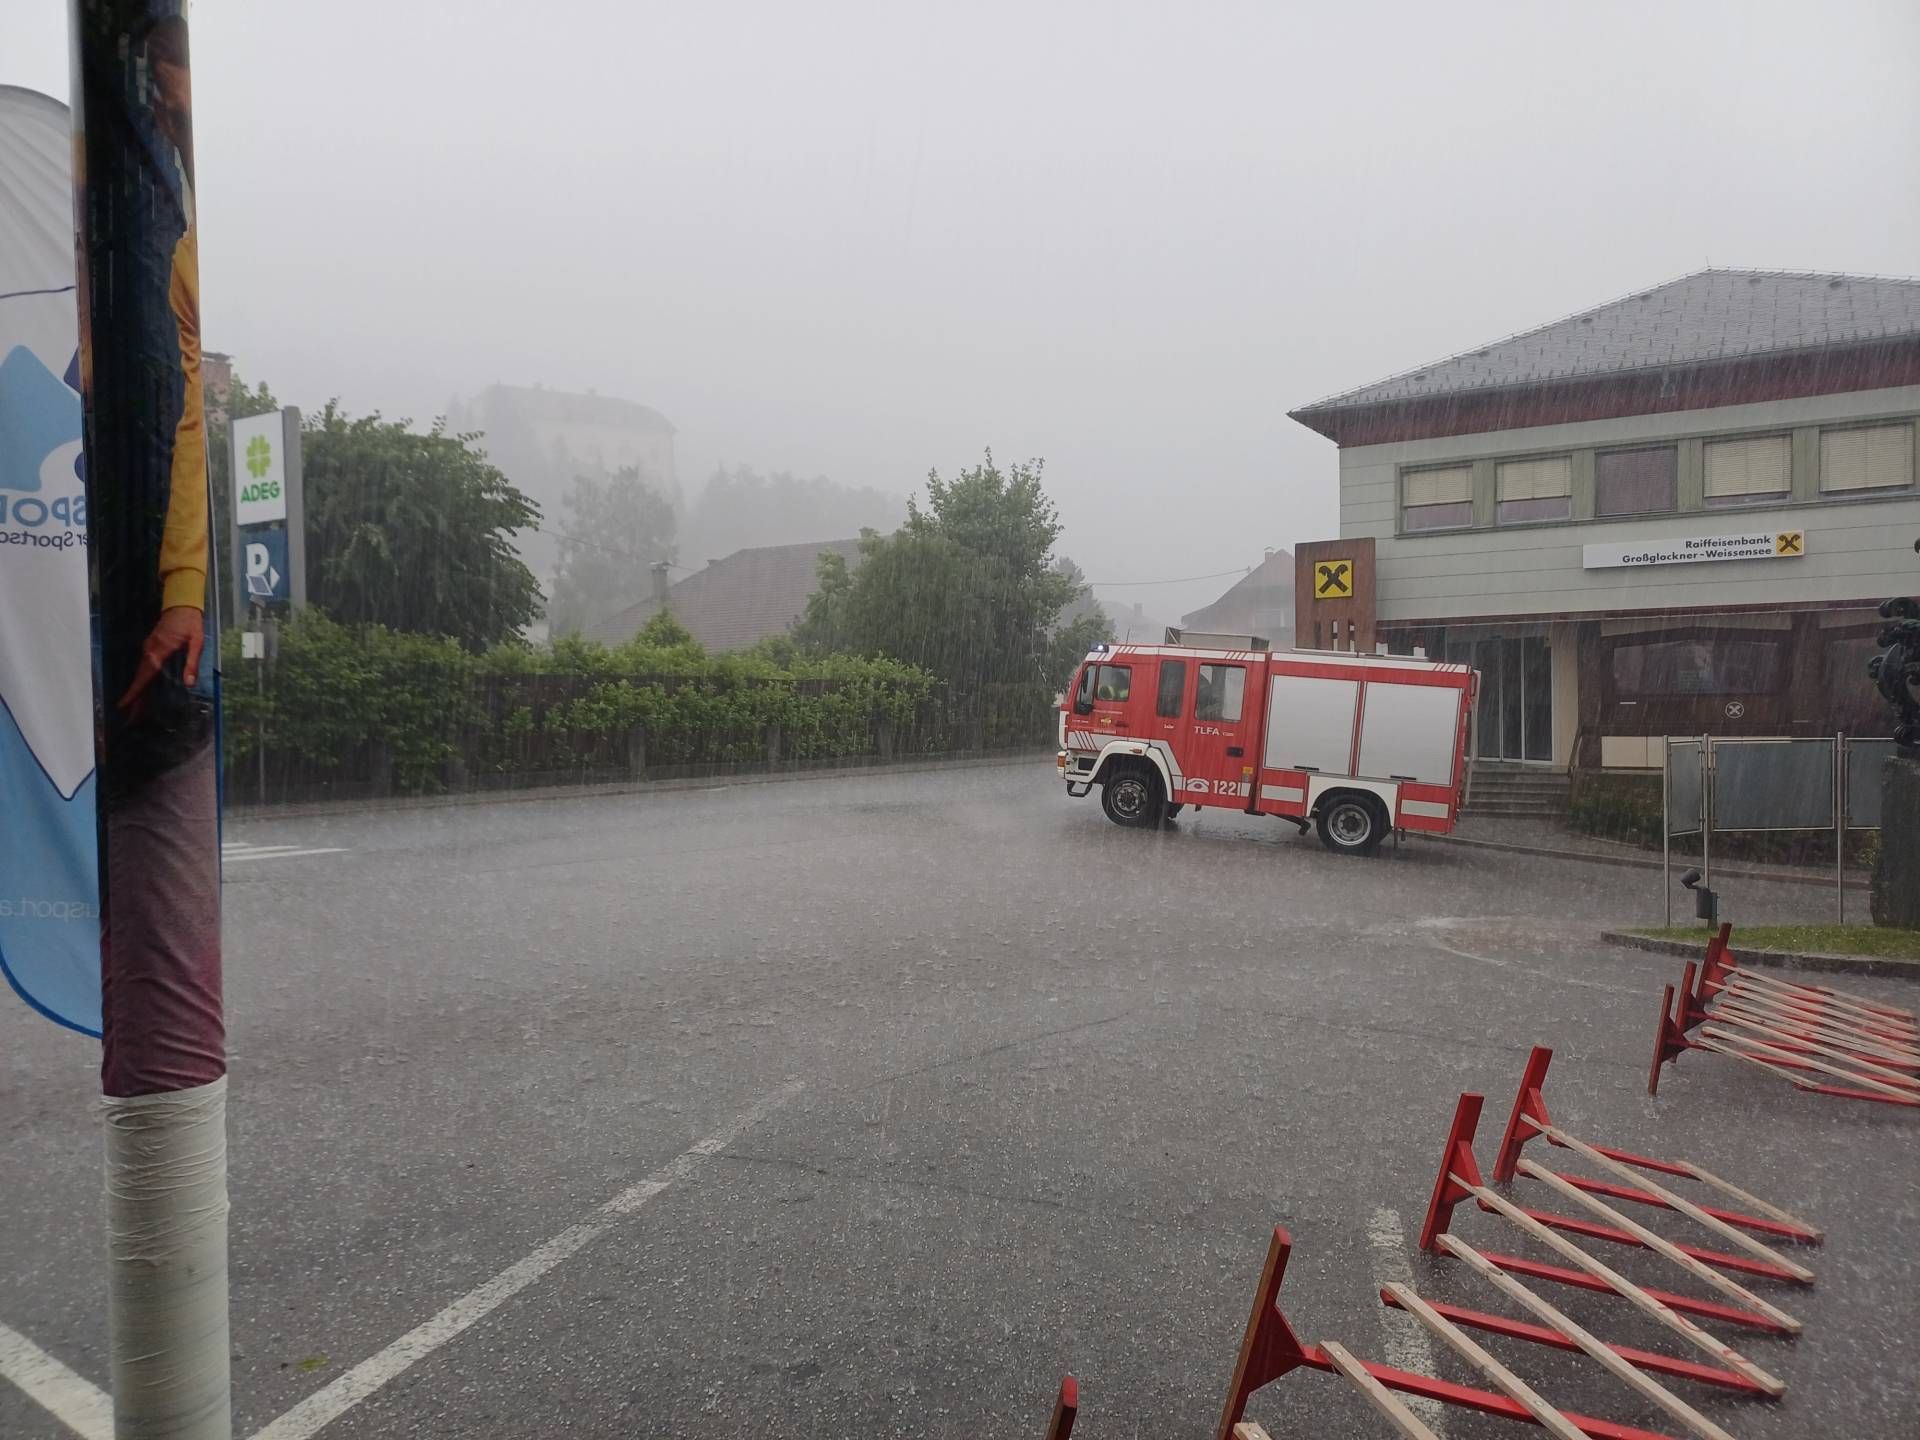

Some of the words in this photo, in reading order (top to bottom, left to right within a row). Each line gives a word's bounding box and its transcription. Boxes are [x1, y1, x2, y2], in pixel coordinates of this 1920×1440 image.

[241, 481, 281, 503] ADEG
[1685, 535, 1771, 549] Raiffeisenbank
[1194, 726, 1220, 736] TLFA
[1213, 780, 1237, 797] 122
